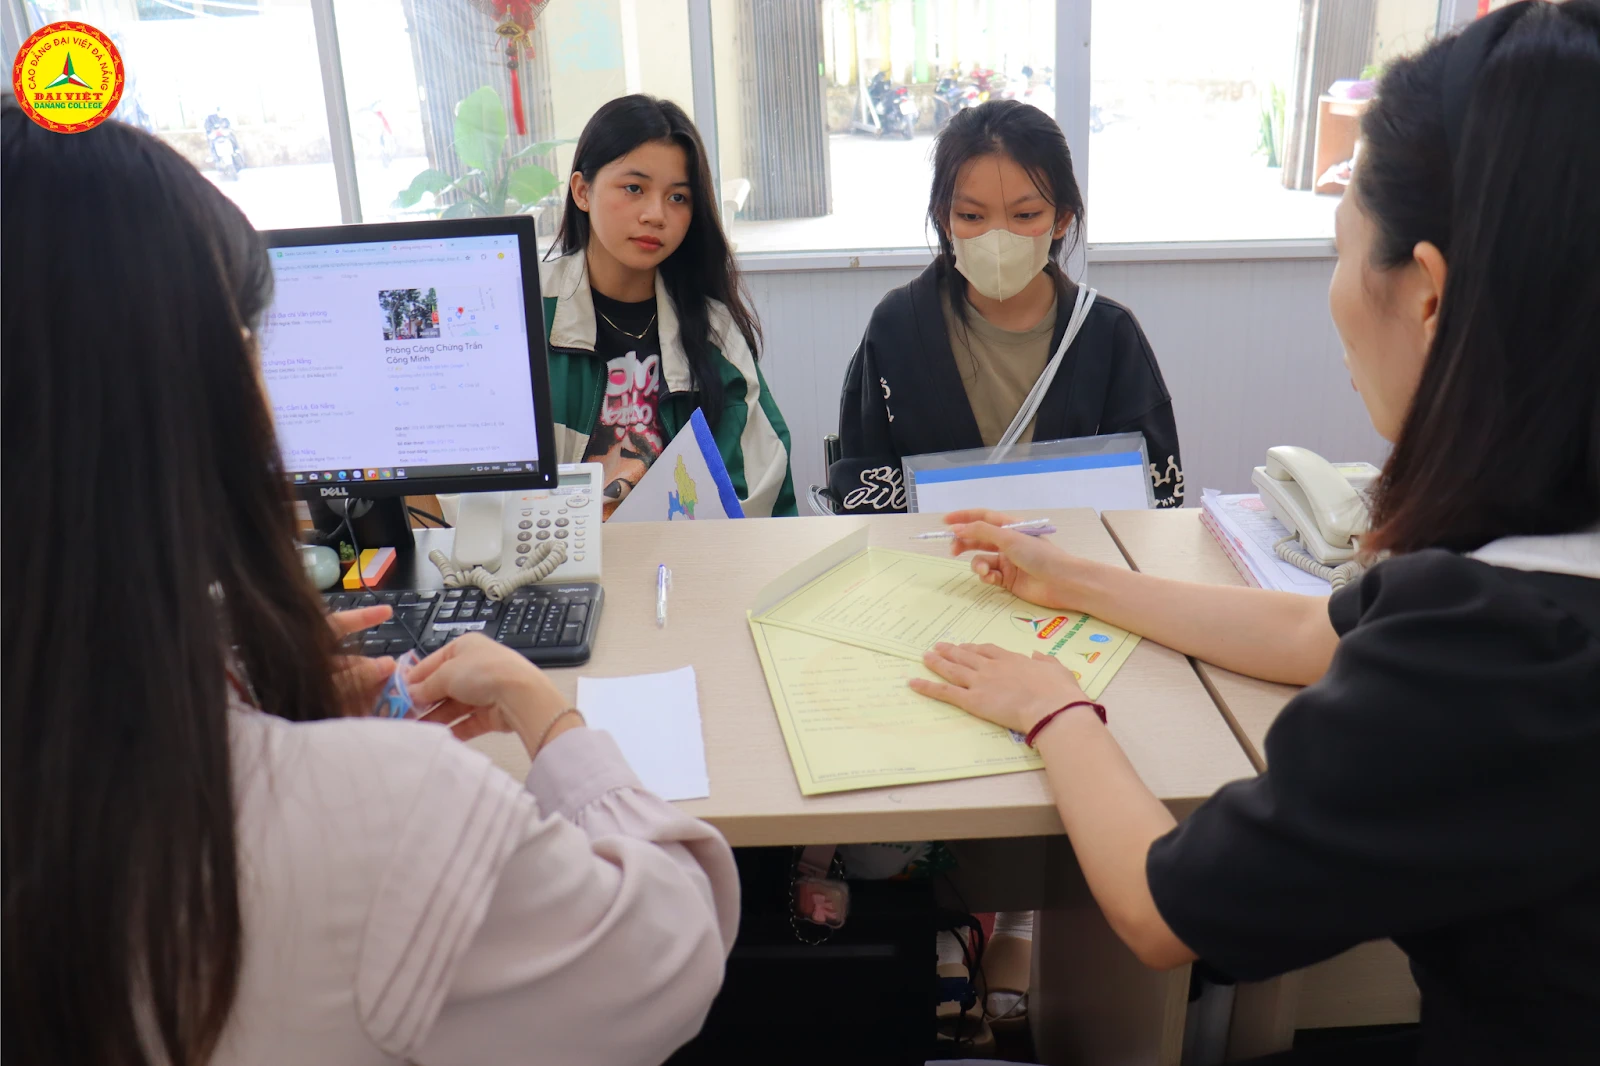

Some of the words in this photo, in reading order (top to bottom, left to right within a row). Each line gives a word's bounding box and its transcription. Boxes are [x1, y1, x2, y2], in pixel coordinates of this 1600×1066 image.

[385, 346, 411, 355] Phòng
[413, 345, 434, 354] Công
[436, 343, 463, 352] Chứng
[386, 357, 408, 365] Công
[320, 487, 349, 496] DELL
[1041, 618, 1062, 637] daiviet
